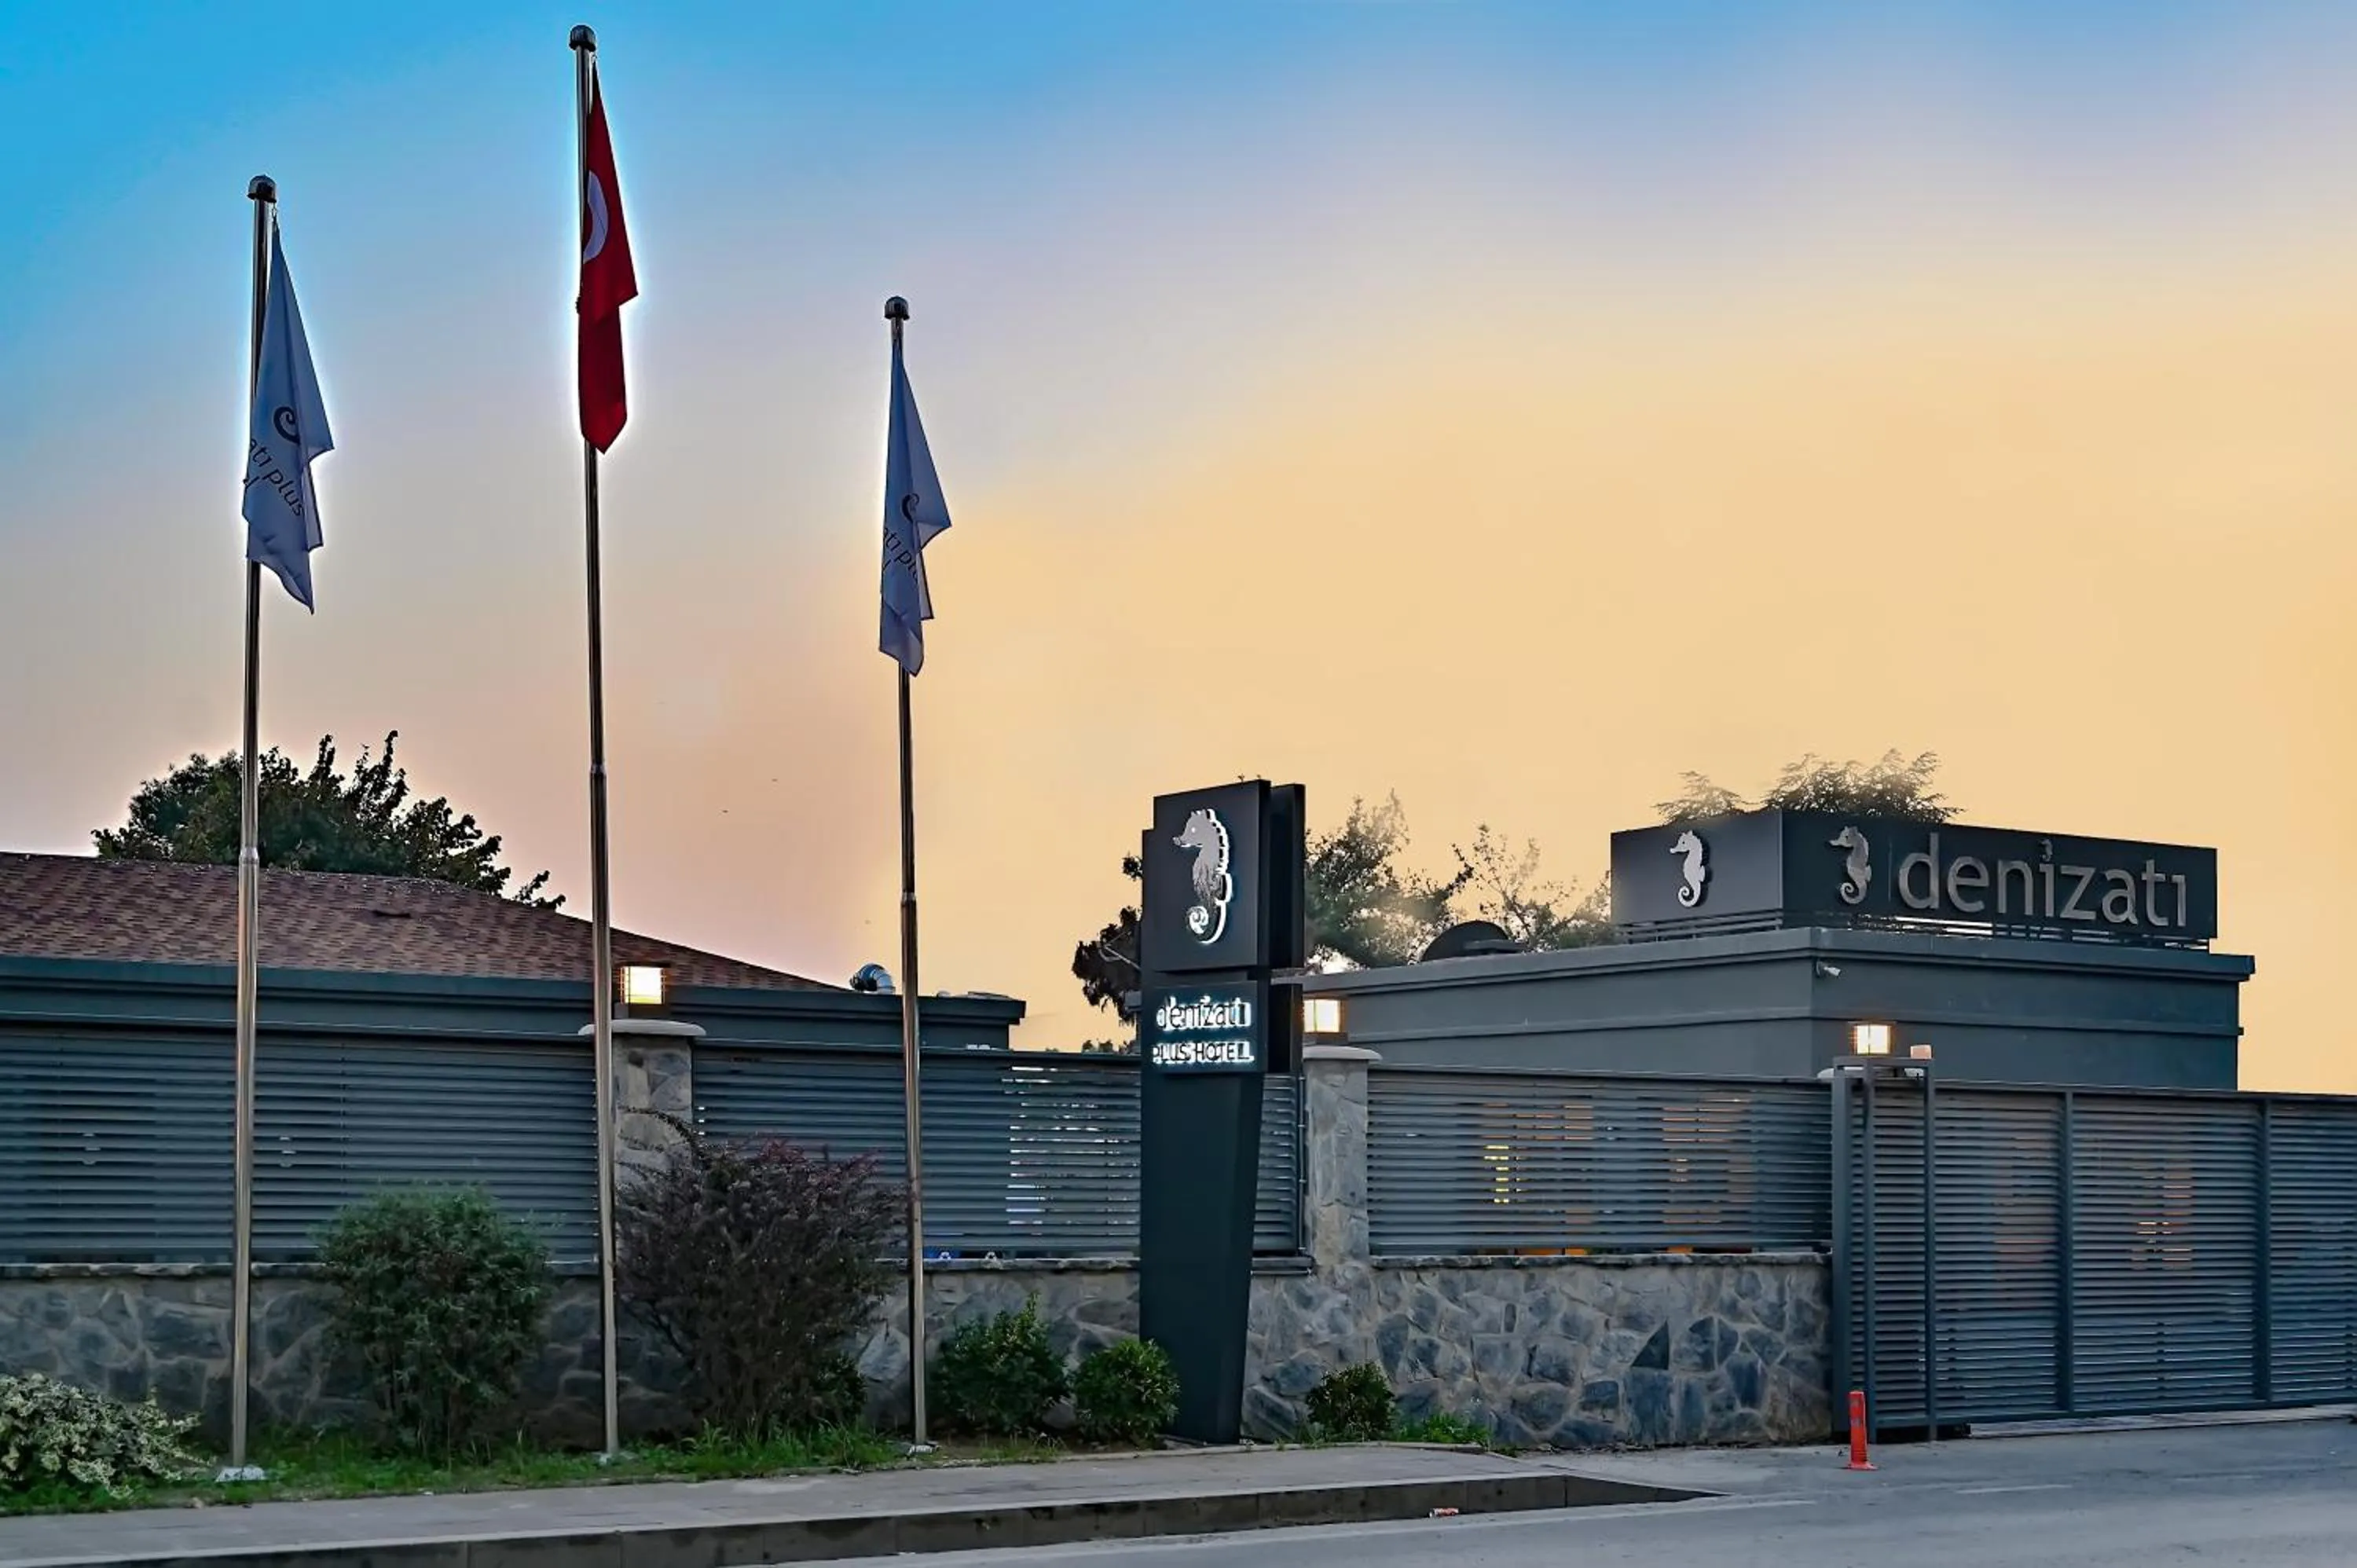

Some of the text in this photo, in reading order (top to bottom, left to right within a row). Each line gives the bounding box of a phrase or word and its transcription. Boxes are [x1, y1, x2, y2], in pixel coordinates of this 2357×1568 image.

[262, 469, 305, 516] plus
[1153, 1040, 1255, 1064] PLUS HOTEL
